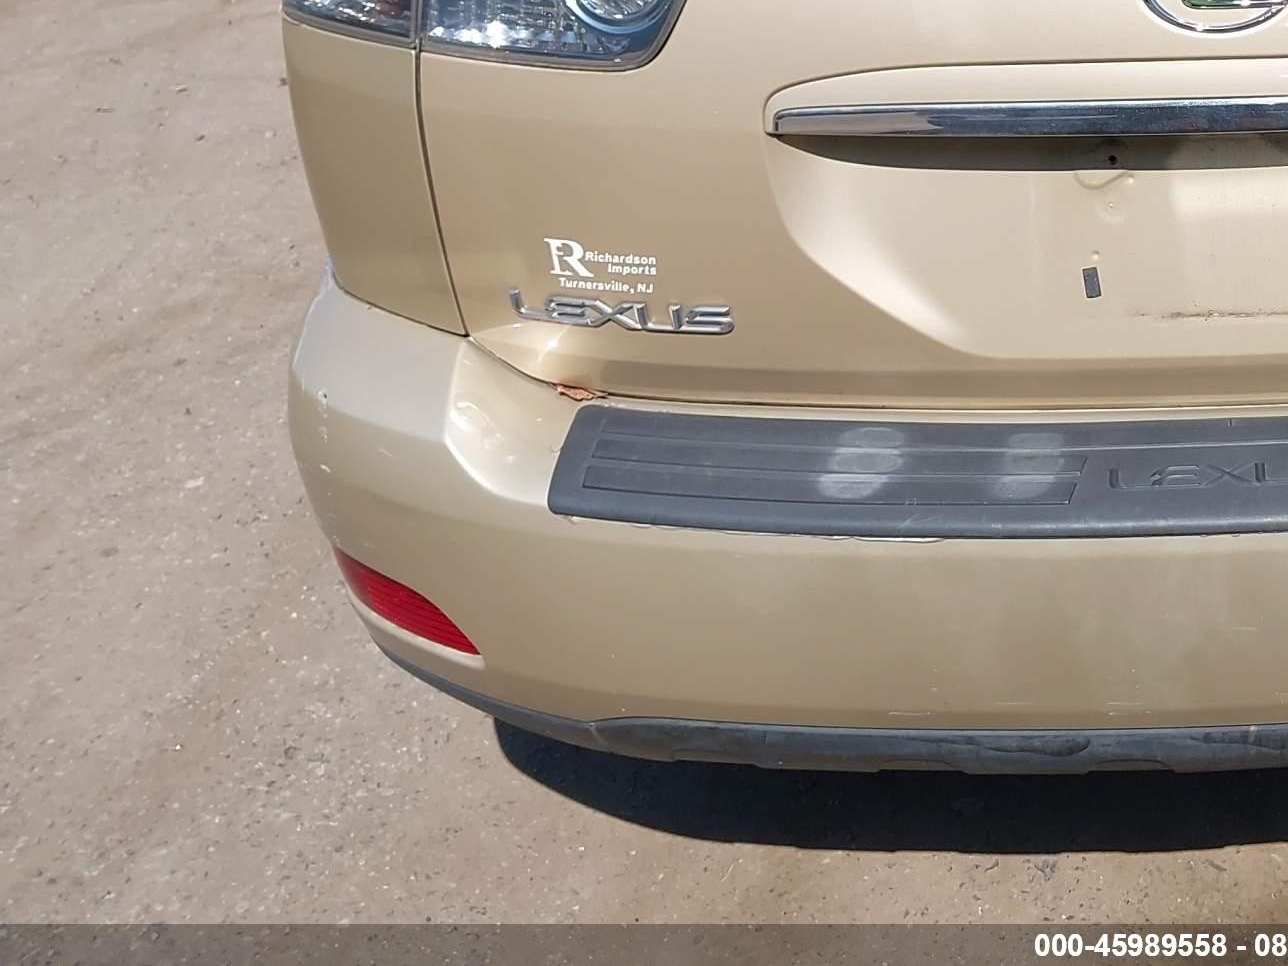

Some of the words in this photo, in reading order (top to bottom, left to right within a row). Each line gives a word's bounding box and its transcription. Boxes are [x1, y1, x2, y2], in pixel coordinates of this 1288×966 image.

[585, 251, 656, 265] Richardson
[607, 264, 656, 275] Imports
[558, 277, 635, 294] Turnersville,
[637, 283, 654, 293] NJ
[509, 289, 734, 335] LEXUS
